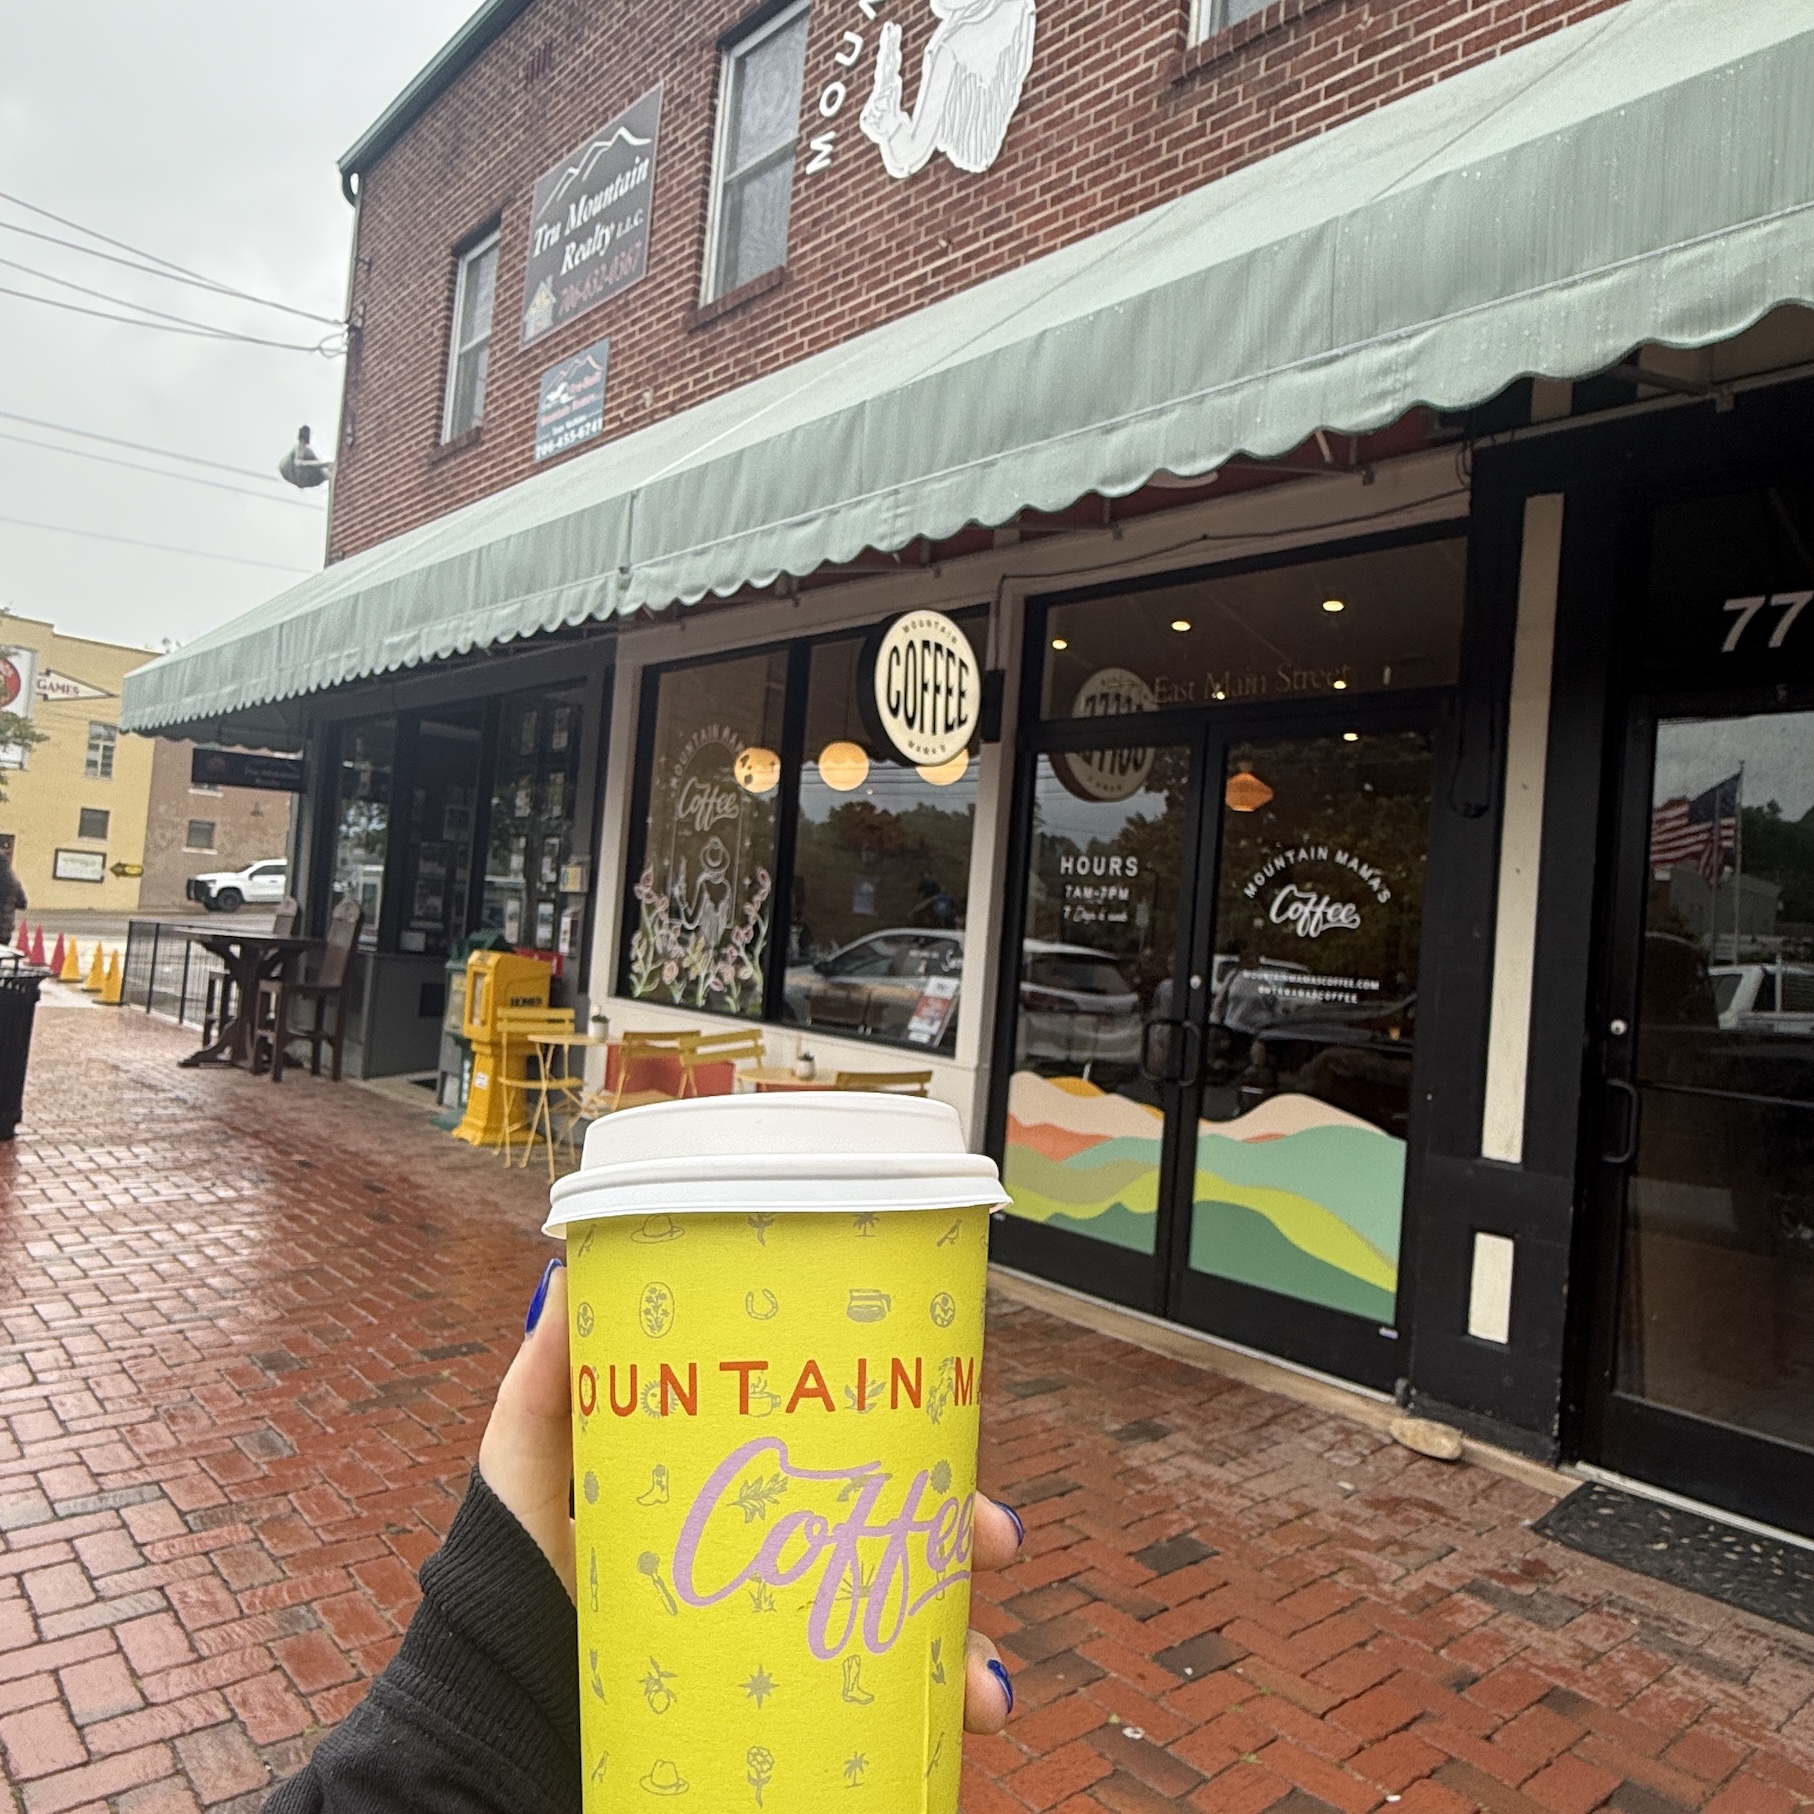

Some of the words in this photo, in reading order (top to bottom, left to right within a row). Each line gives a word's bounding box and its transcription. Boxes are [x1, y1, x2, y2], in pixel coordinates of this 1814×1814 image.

[532, 222, 562, 258] Tru
[563, 155, 650, 236] Mountain
[560, 221, 615, 277] Realty
[1720, 590, 1814, 653] 77
[37, 679, 80, 695] GAMES
[886, 639, 970, 736] COFFEE
[1153, 674, 1197, 704] East
[1203, 668, 1267, 701] Main
[1275, 663, 1353, 693] Street
[669, 723, 721, 790] MOUNTAIN
[677, 776, 740, 833] Coffee
[1060, 855, 1139, 877] HOURS
[1243, 845, 1329, 898] MOUNTAIN
[1334, 850, 1392, 903] MAMA'S
[1269, 883, 1361, 938] Coffee
[571, 1357, 923, 1416] OUNTAIN
[954, 1356, 980, 1407] M
[672, 1436, 975, 1660] Coffee
